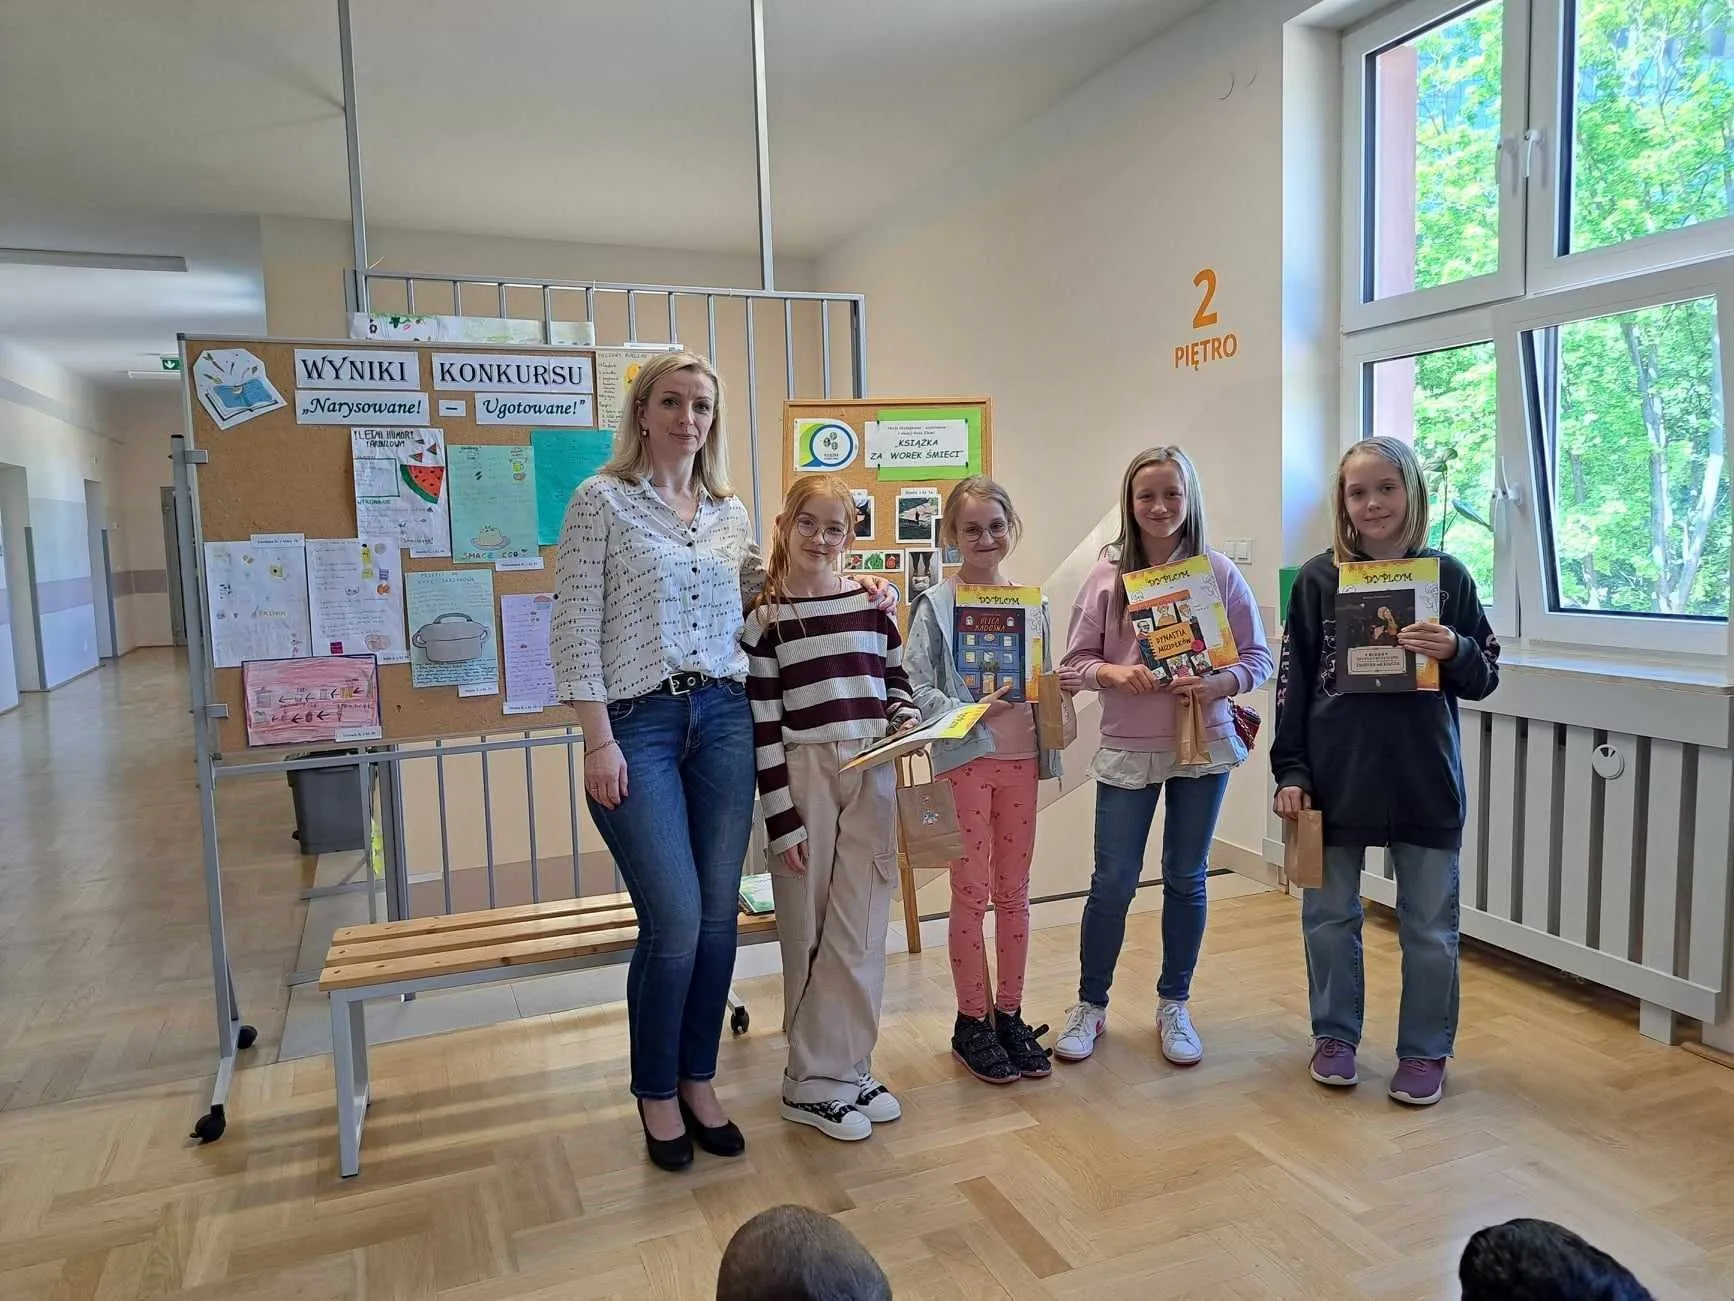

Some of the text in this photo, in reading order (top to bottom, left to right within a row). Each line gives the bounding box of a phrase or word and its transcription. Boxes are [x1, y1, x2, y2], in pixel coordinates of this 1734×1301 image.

[1192, 269, 1217, 329] 2
[1175, 334, 1237, 371] PIĘTRO
[301, 353, 583, 386] WYNIKI KONKURSU
[302, 397, 422, 418] „Narysowane!
[482, 399, 586, 419] Ugotowane!”
[870, 452, 883, 460] ZA
[890, 451, 922, 460] WOREK
[1145, 569, 1190, 586] DYPLOM
[1363, 573, 1414, 584] DYPLOM
[979, 595, 1021, 605] DYPLOM
